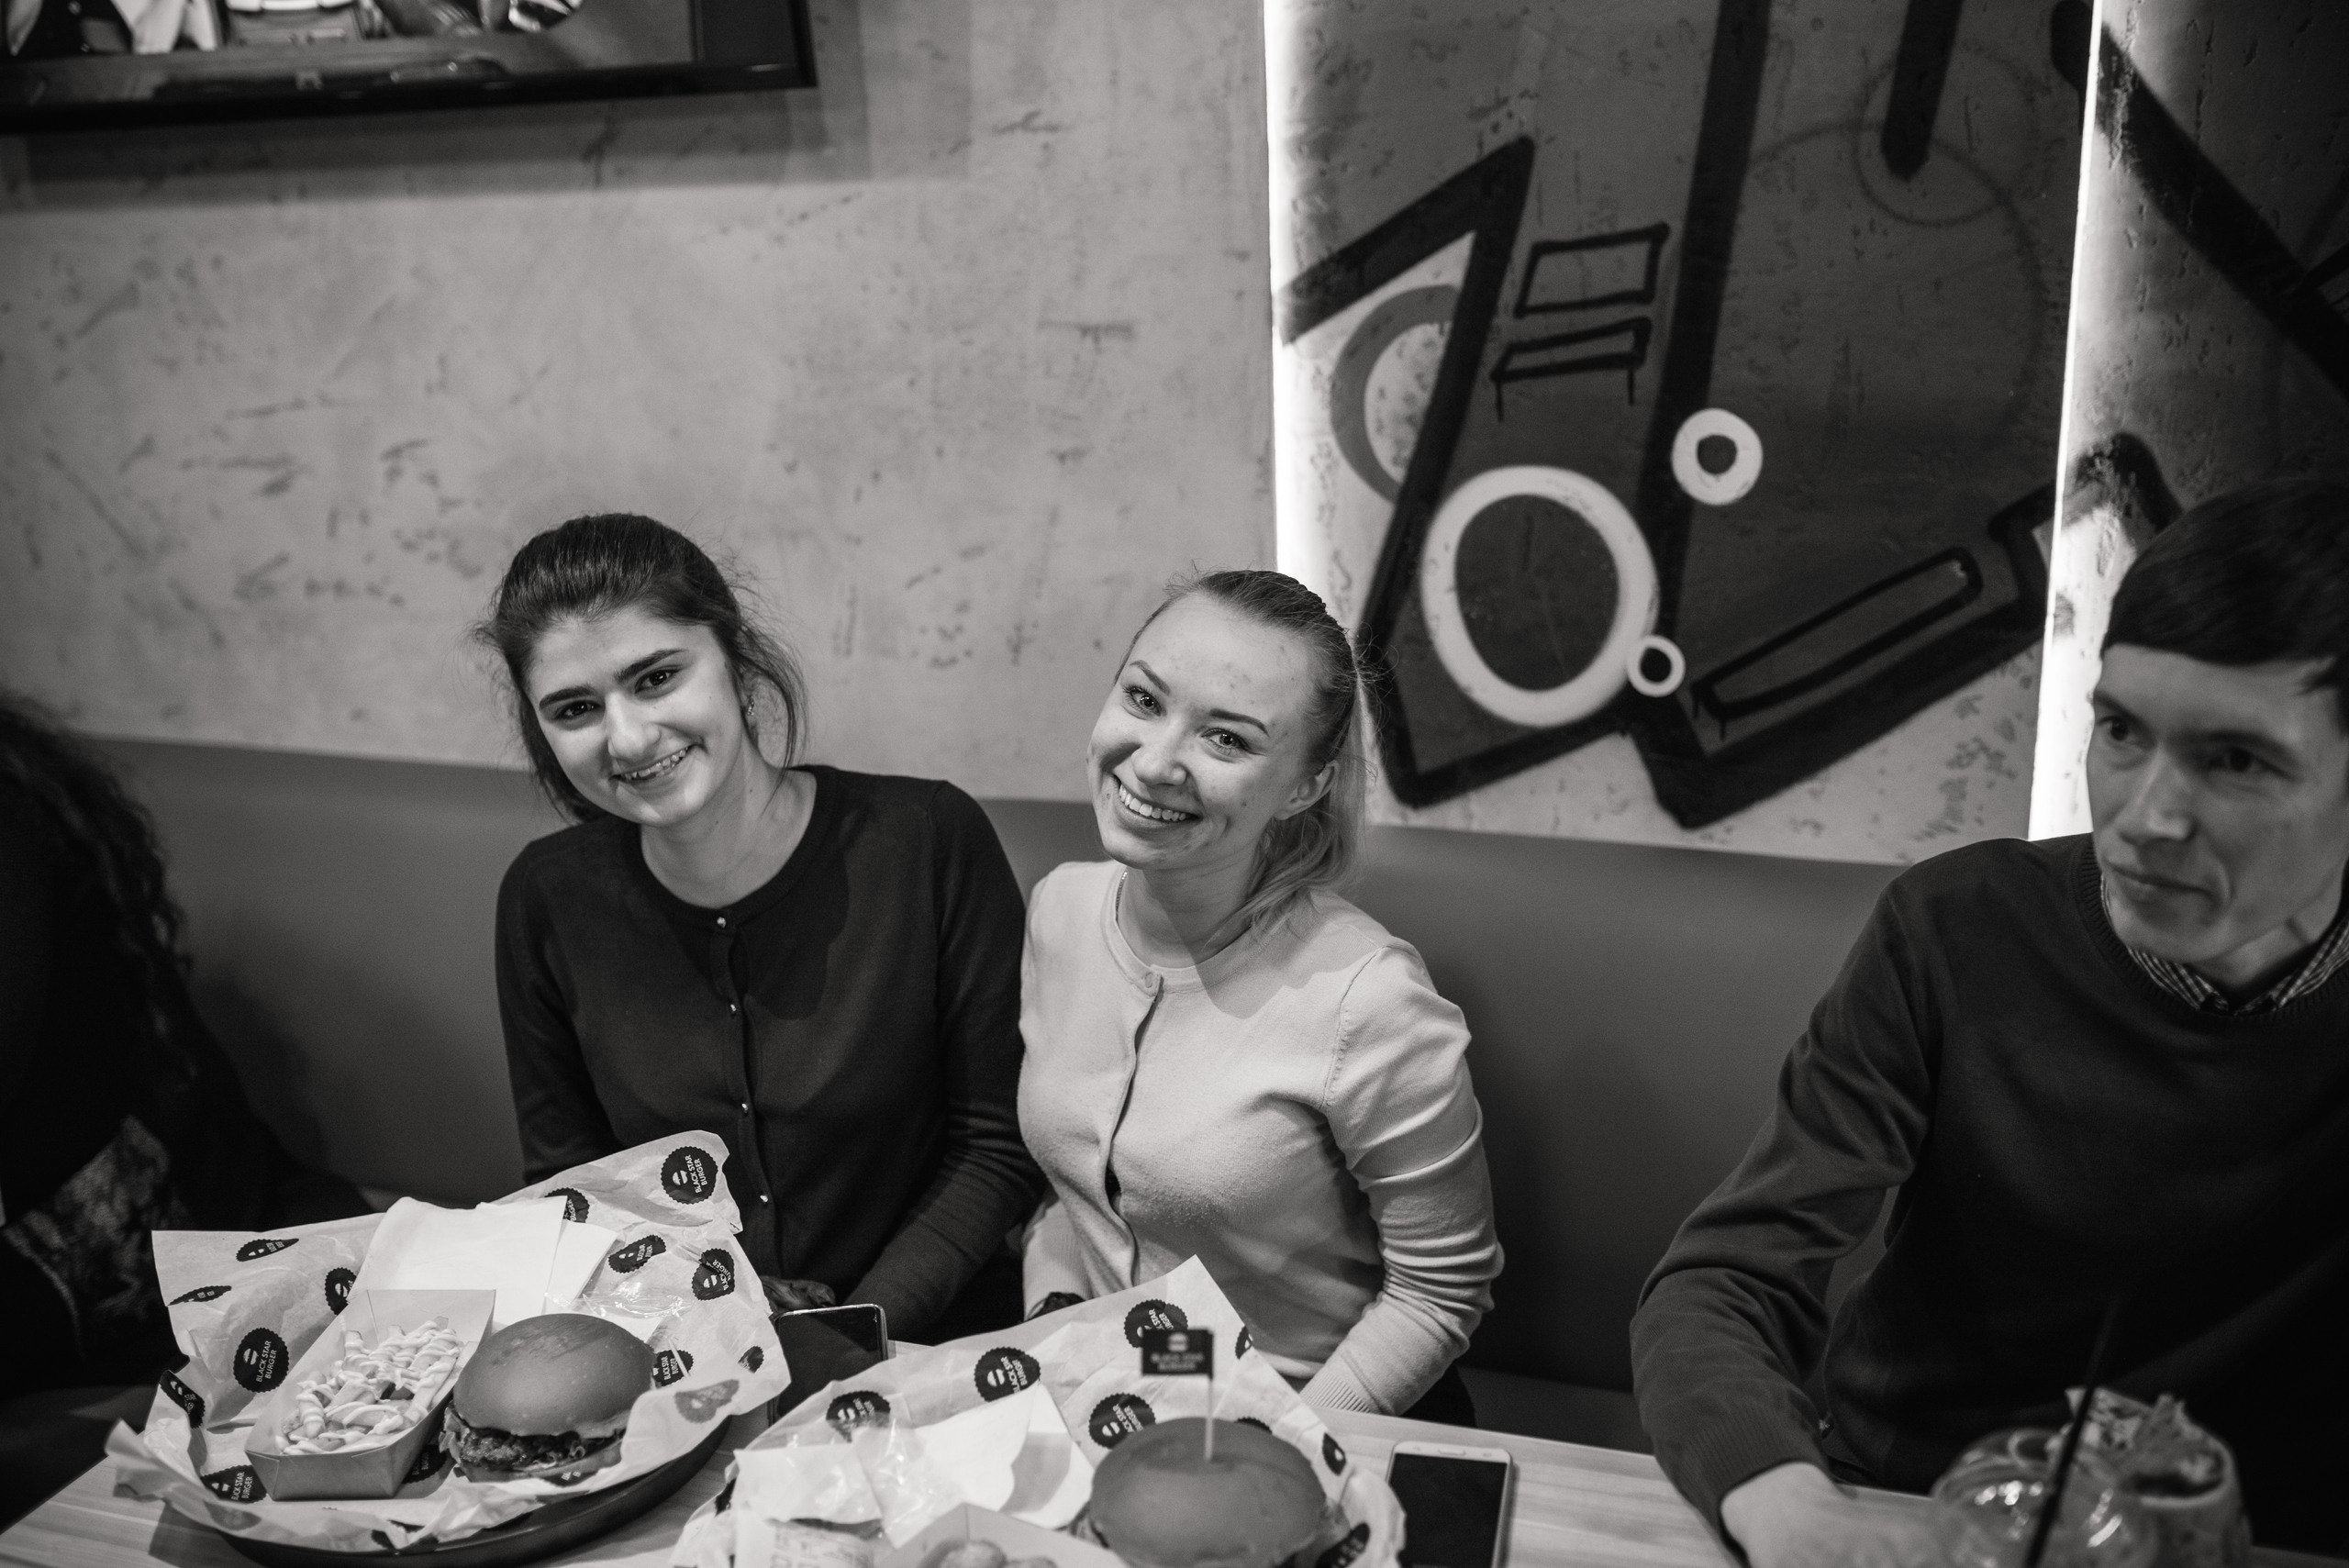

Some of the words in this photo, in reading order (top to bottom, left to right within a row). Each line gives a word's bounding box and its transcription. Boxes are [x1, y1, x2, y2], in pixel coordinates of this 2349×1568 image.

[685, 1154, 696, 1172] STAR
[694, 1158, 707, 1185] BURGER
[690, 1172, 702, 1193] BLACK
[1149, 1308, 1161, 1326] STAR
[1159, 1312, 1174, 1329] URGER
[256, 1359, 267, 1382] BLACK
[262, 1340, 272, 1359] STAR
[264, 1349, 277, 1379] BURGER
